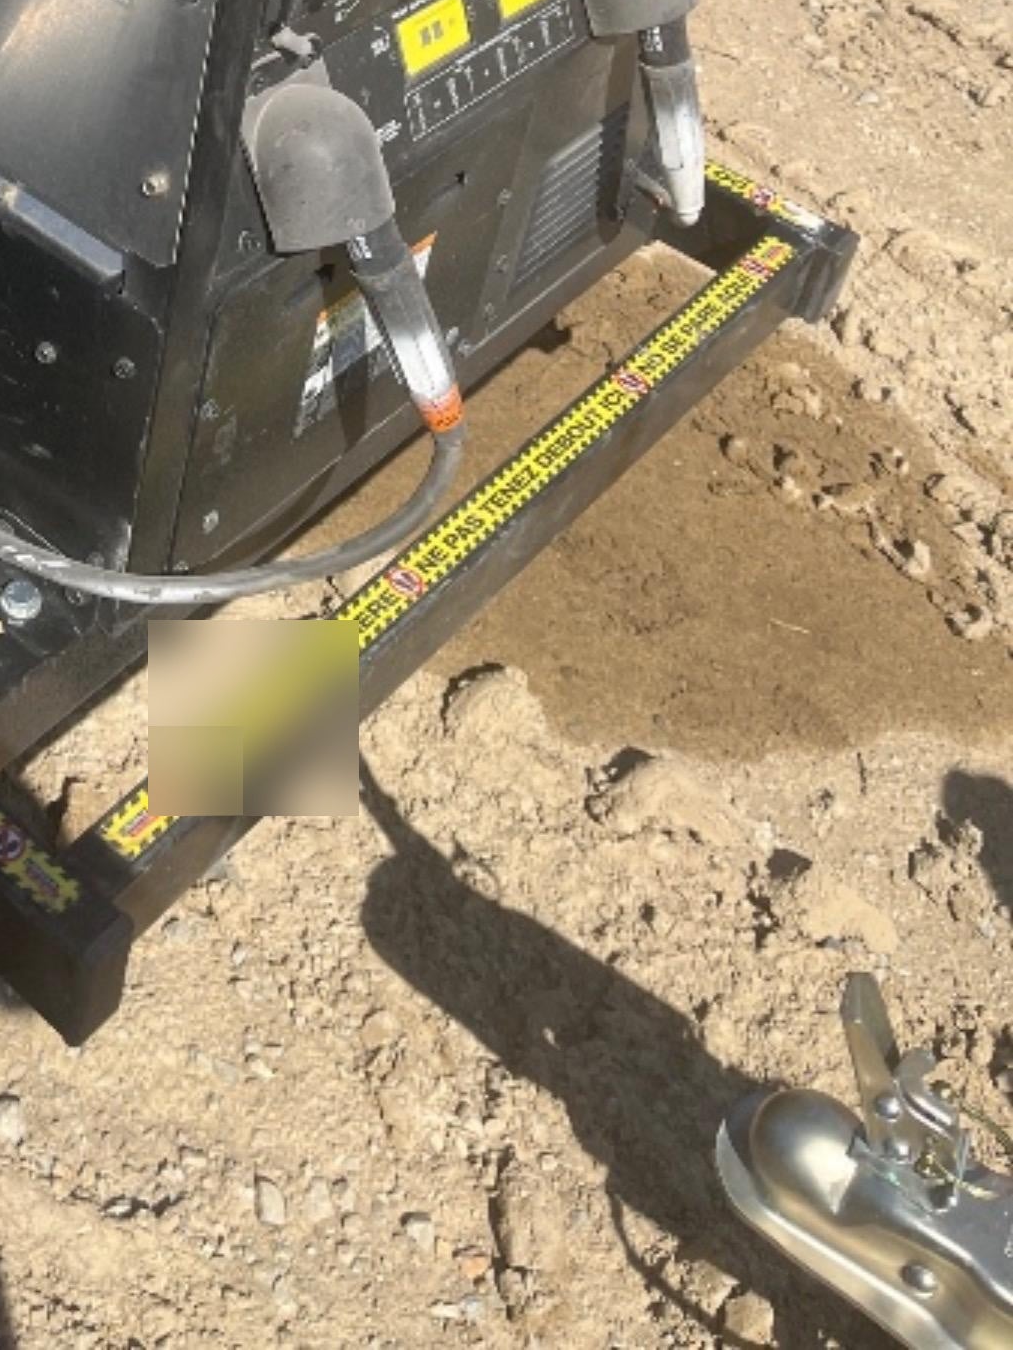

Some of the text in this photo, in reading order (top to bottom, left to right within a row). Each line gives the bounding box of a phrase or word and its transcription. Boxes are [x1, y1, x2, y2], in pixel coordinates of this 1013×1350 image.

[414, 548, 449, 576] NE
[446, 516, 486, 551] PAS
[480, 464, 538, 517] TENEZ
[534, 413, 606, 469] DEBOUT
[356, 590, 400, 634] ERE
